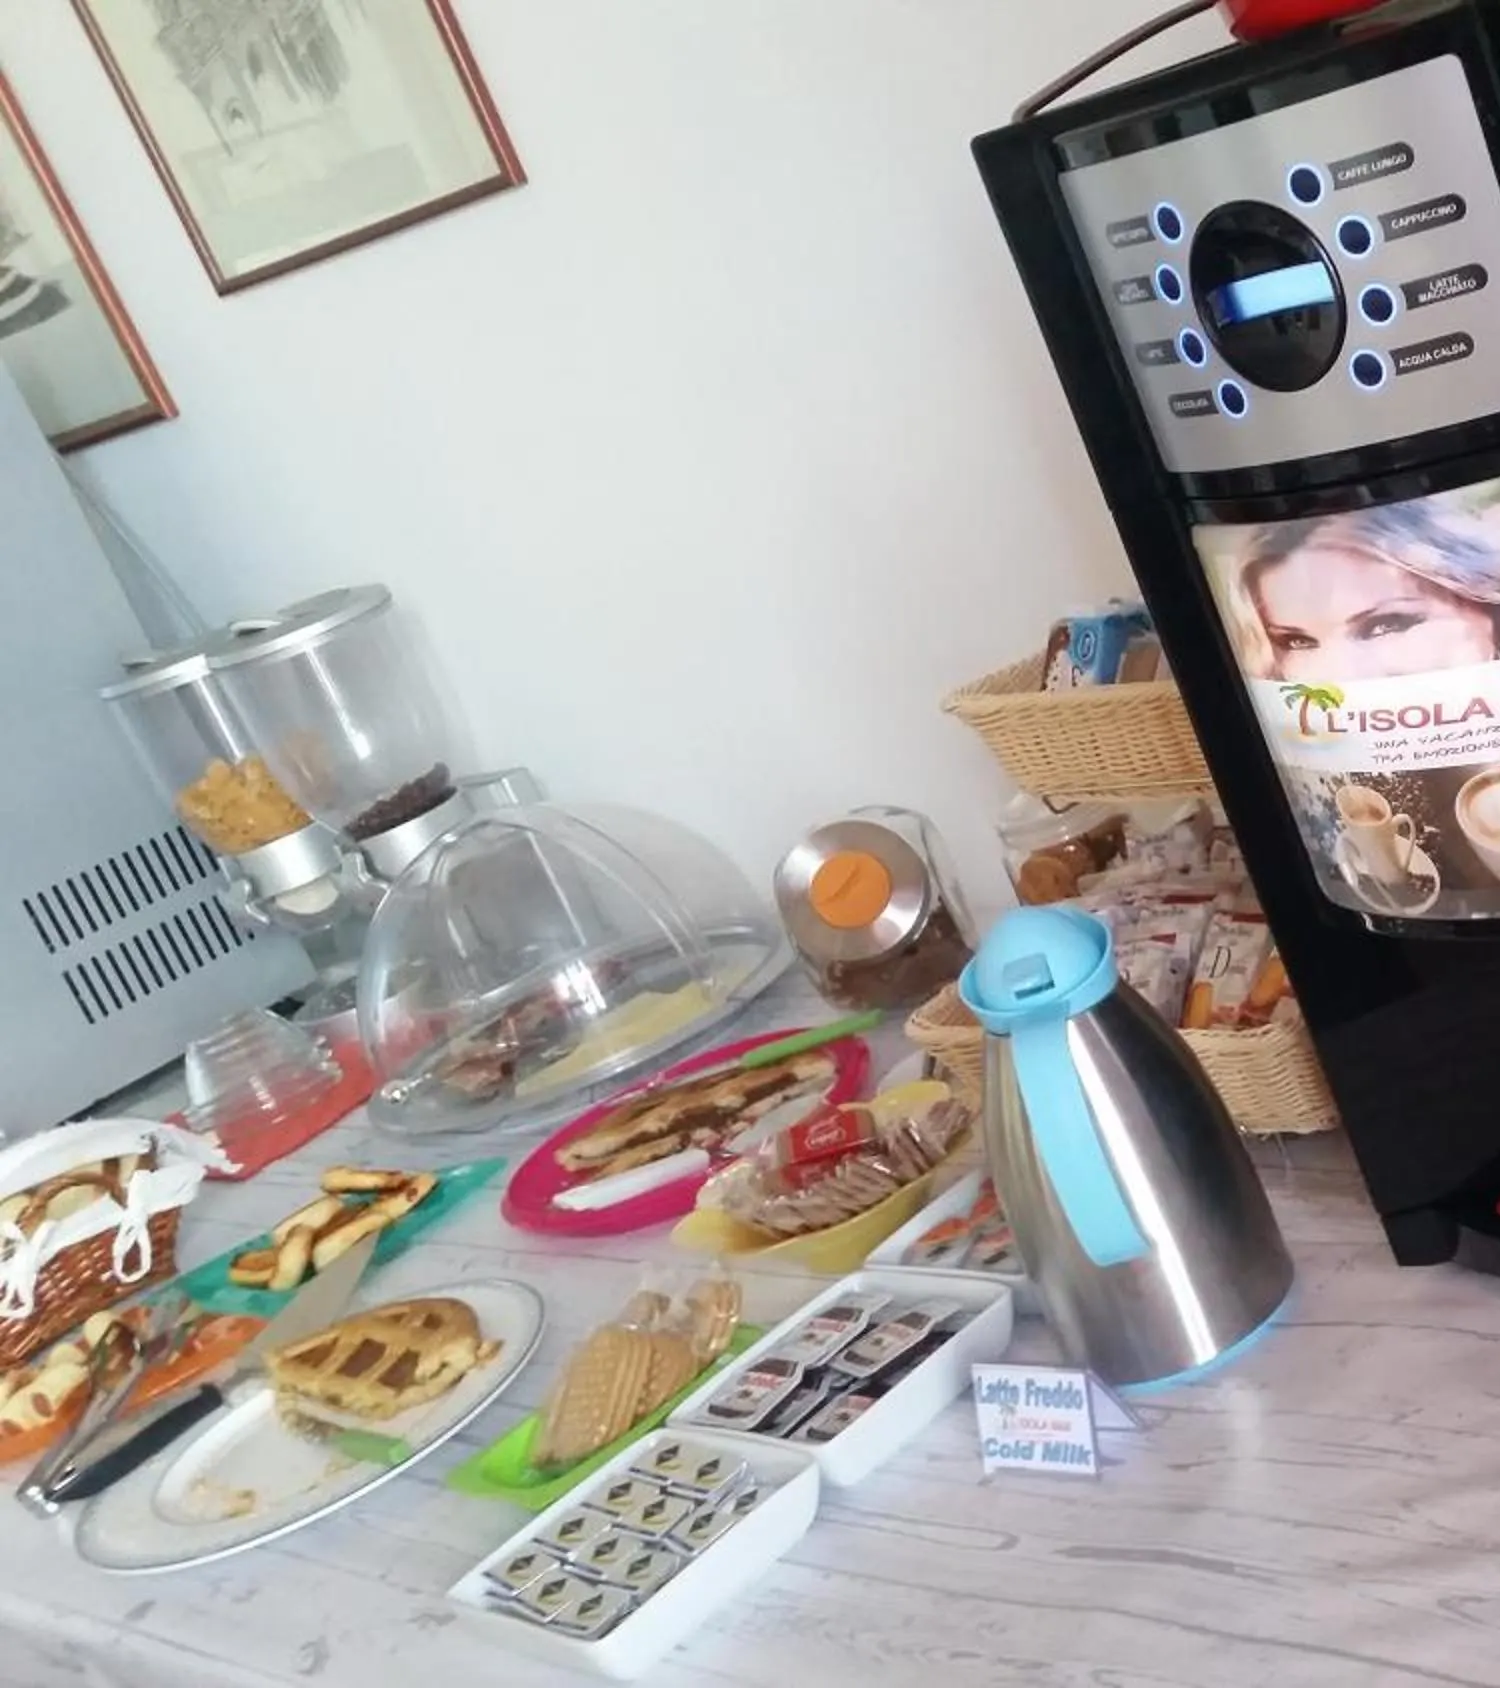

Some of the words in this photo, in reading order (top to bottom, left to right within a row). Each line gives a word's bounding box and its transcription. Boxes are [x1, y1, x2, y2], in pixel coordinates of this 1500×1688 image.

[1371, 153, 1407, 172] LUNGO
[1391, 203, 1457, 229] CAPPUCCINO
[1429, 273, 1460, 291] LATTE
[1399, 352, 1432, 368] ACQUA
[1433, 343, 1467, 360] CALDA
[1327, 697, 1494, 733] L'ISOLA
[977, 1375, 1020, 1405] Latte
[1025, 1378, 1084, 1410] Freddo
[984, 1437, 1036, 1461] Cold
[1041, 1440, 1092, 1466] Milk
